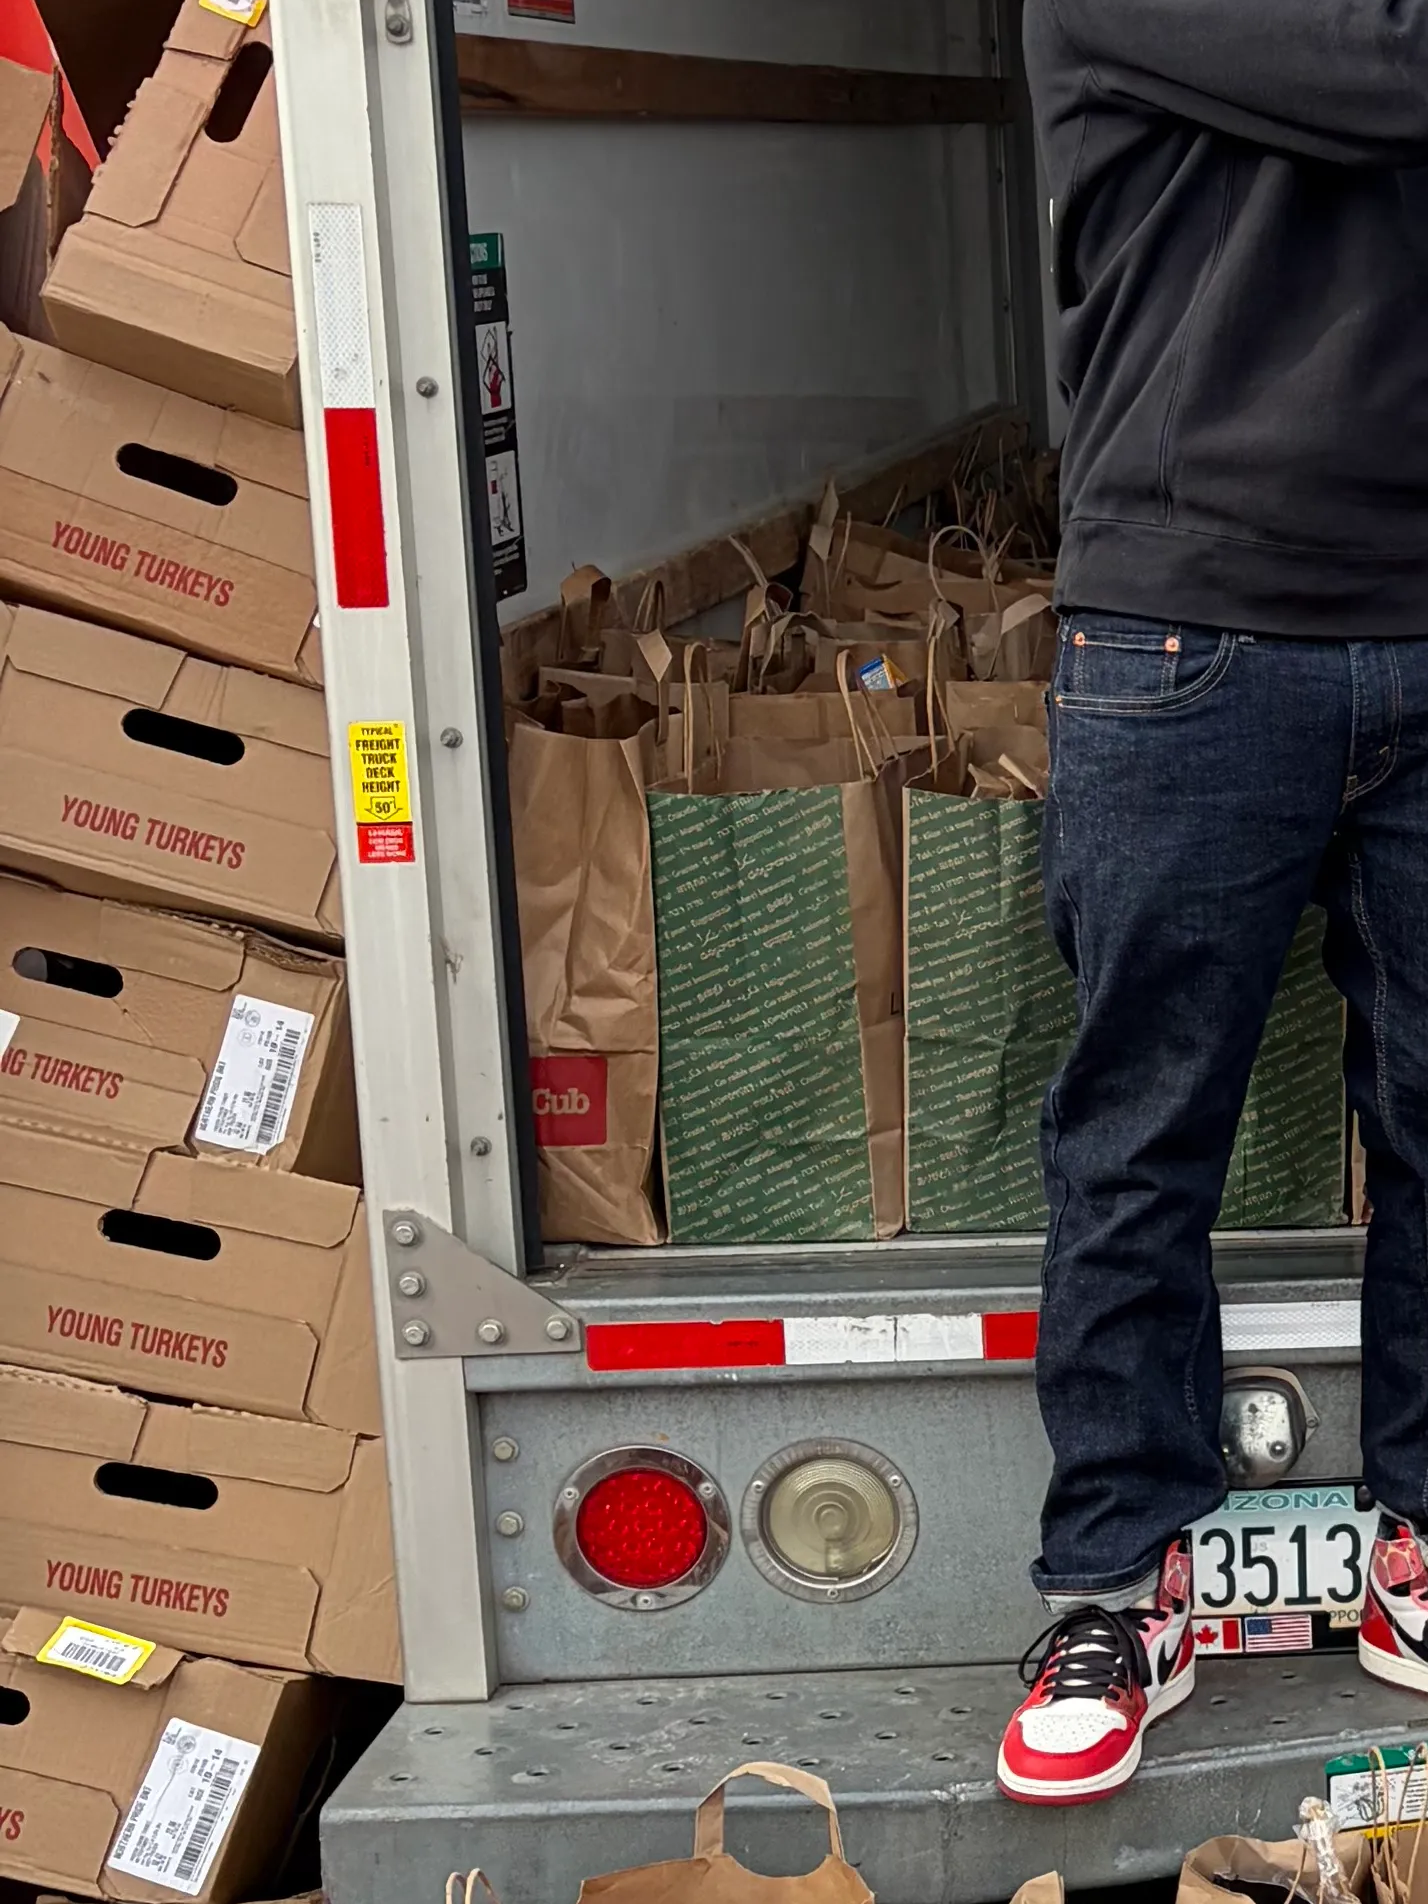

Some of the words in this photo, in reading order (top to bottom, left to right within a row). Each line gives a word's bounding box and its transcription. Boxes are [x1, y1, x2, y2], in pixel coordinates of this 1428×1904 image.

[51, 521, 131, 576] YOUNG
[134, 549, 234, 607] TURKEYS
[356, 739, 400, 750] FREIGHT
[361, 753, 396, 764] TRUCK
[362, 781, 400, 792] HEIGHT
[366, 767, 394, 778] DECK
[61, 795, 139, 842] YOUNG
[144, 821, 245, 870] TURKEYS
[31, 1054, 125, 1101] TURKEYS
[45, 1305, 123, 1351] YOUNG
[129, 1320, 229, 1369] TURKEYS
[1223, 1492, 1349, 1512] IZONA
[45, 1560, 123, 1604] YOUNG
[129, 1573, 230, 1618] TURKEYS
